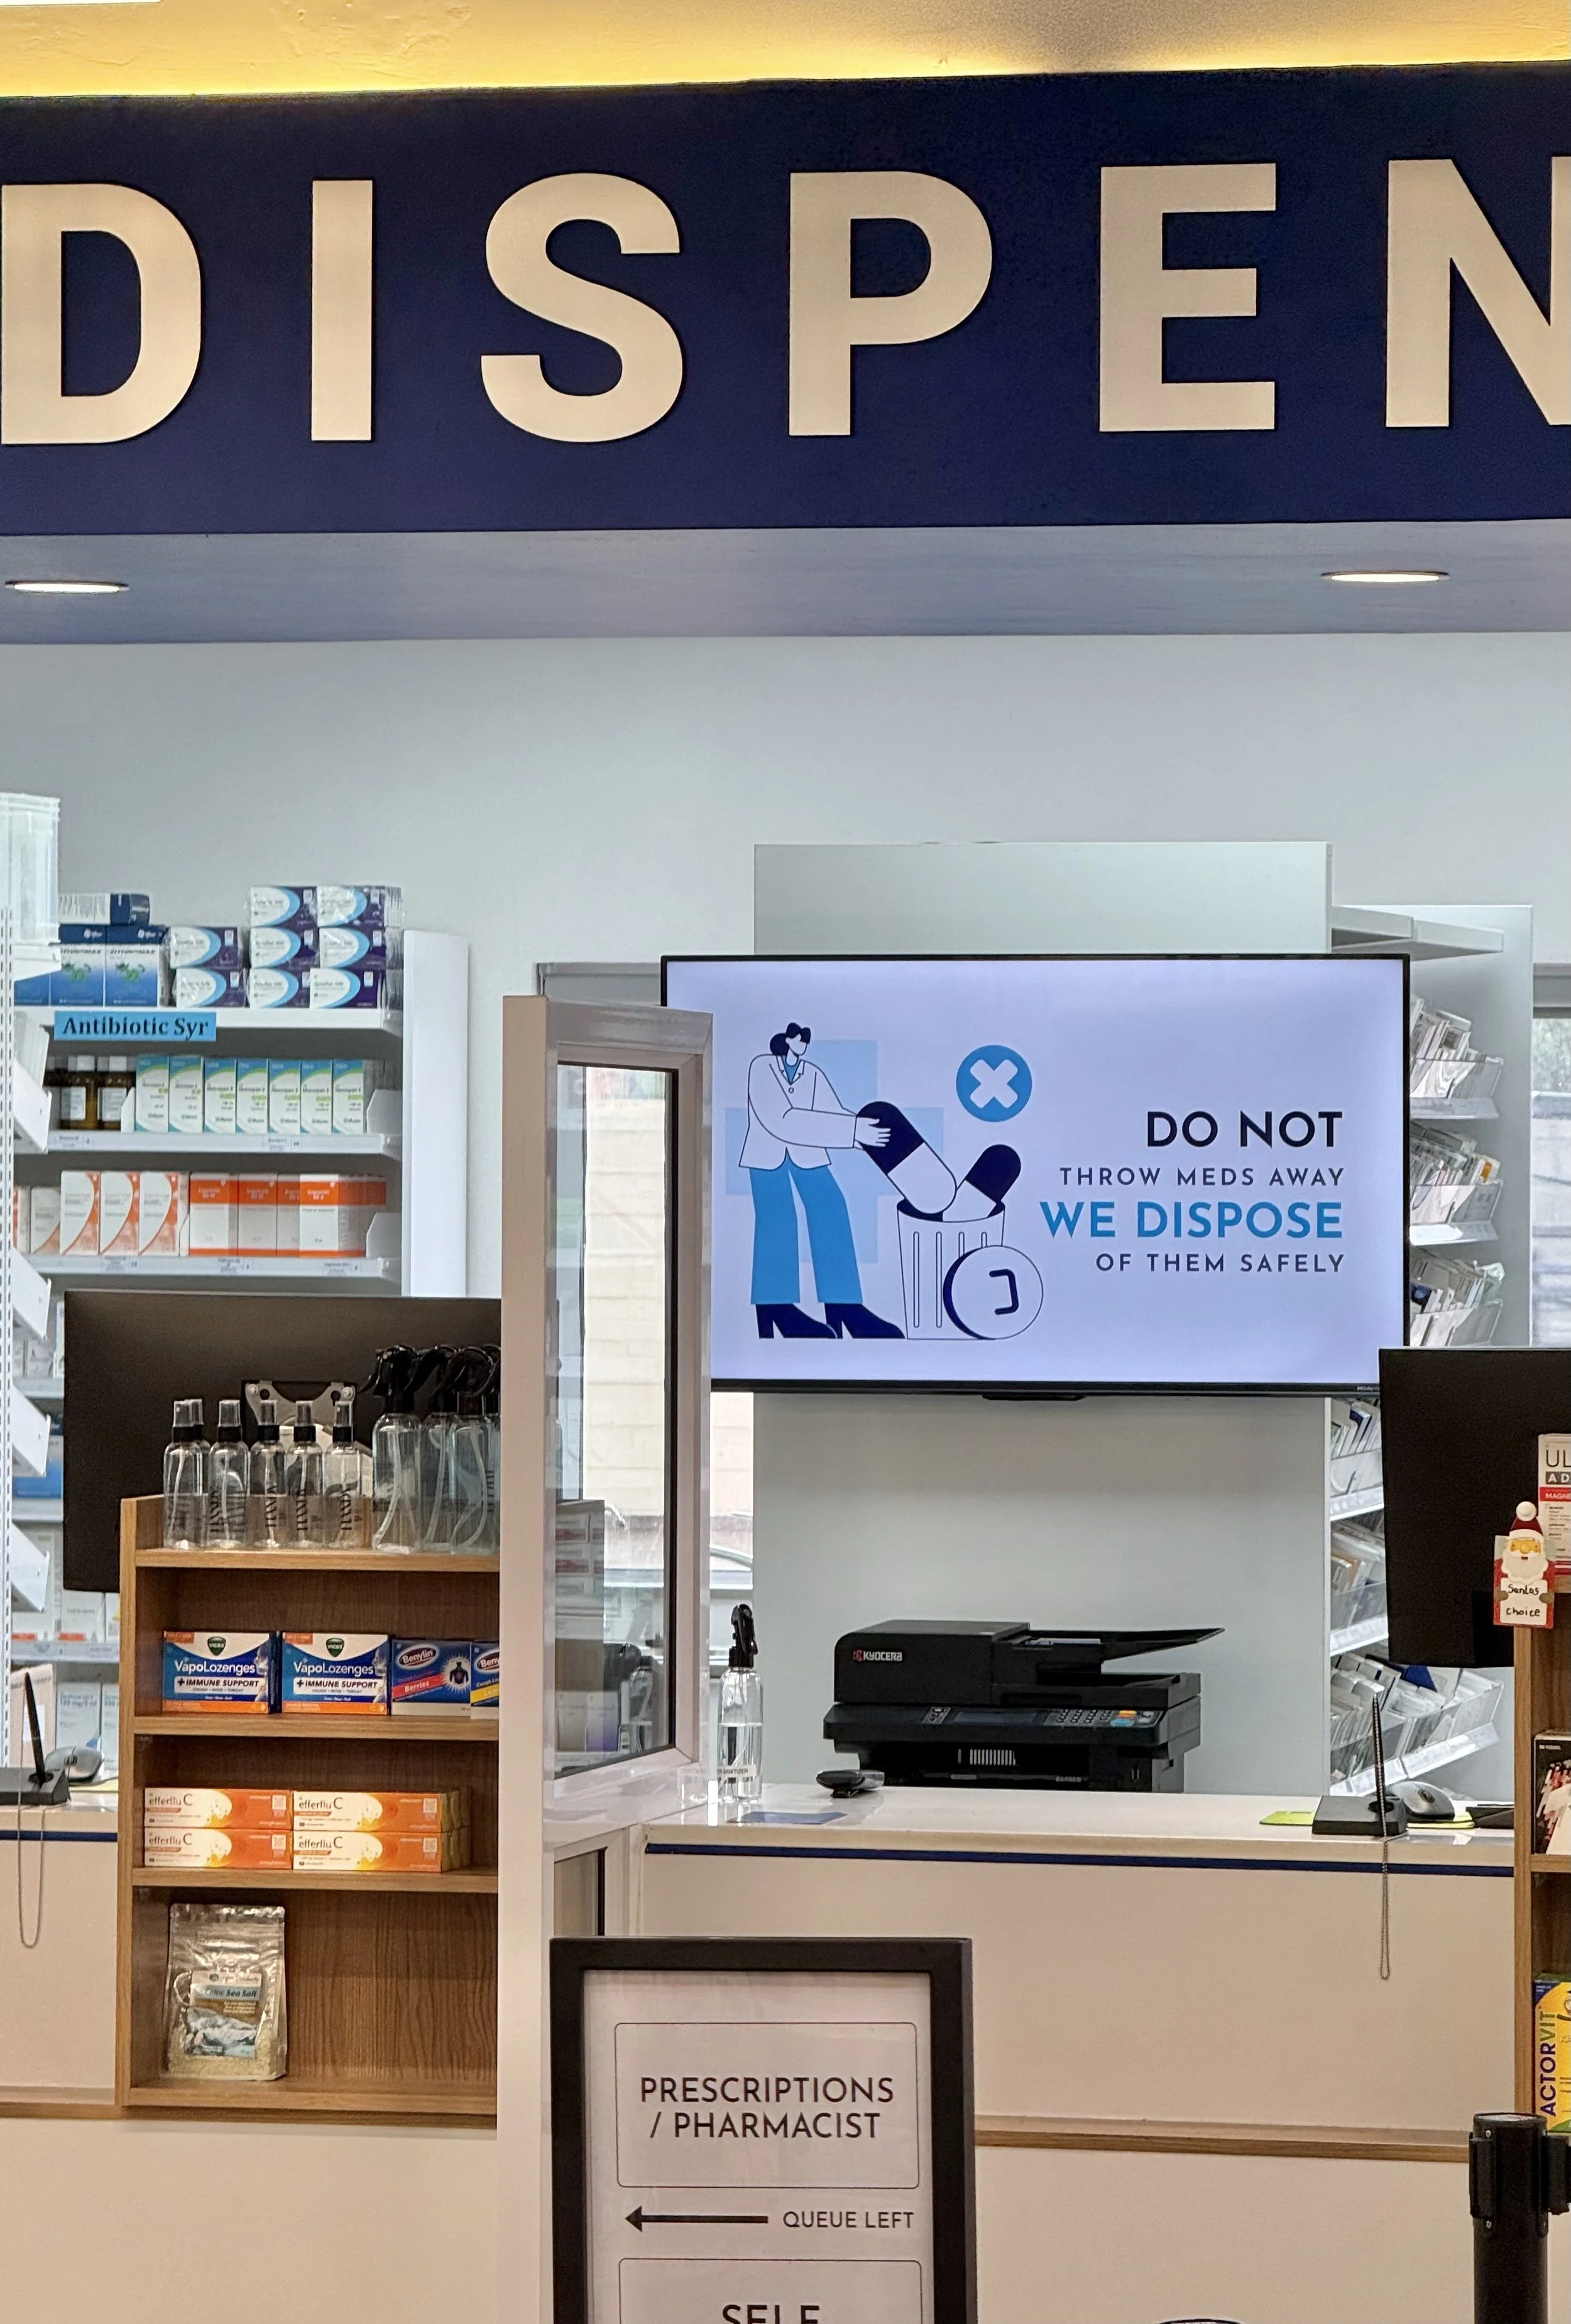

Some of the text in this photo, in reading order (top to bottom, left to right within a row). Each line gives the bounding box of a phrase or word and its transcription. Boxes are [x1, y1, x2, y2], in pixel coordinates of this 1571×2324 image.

[0, 157, 1571, 446] DISPEN
[62, 1015, 209, 1040] Antibiotic Syr
[1147, 1110, 1342, 1148] DO NOT
[1060, 1167, 1344, 1186] THROW MEDS AWAY
[1039, 1201, 1342, 1238] WE DISPOSE
[1096, 1253, 1344, 1273] OF THEM SAFELY
[402, 1649, 434, 1664] Benylin
[863, 1650, 902, 1662] KYOCERA
[174, 1660, 256, 1676] VapoLozenges
[293, 1661, 374, 1677] VapoLozenges
[186, 1679, 220, 1687] IMMUNE
[222, 1679, 259, 1688] SUPPORT
[405, 1681, 430, 1693] Berries
[149, 1793, 193, 1806] efferflu C
[298, 1796, 344, 1810] efferflu C
[183, 1832, 193, 1846] C
[333, 1835, 344, 1849] C
[640, 2076, 894, 2103] PRESCRIPTIONS
[674, 2111, 881, 2139] PHARMACIST
[783, 2211, 914, 2229] QUEUE LEFT
